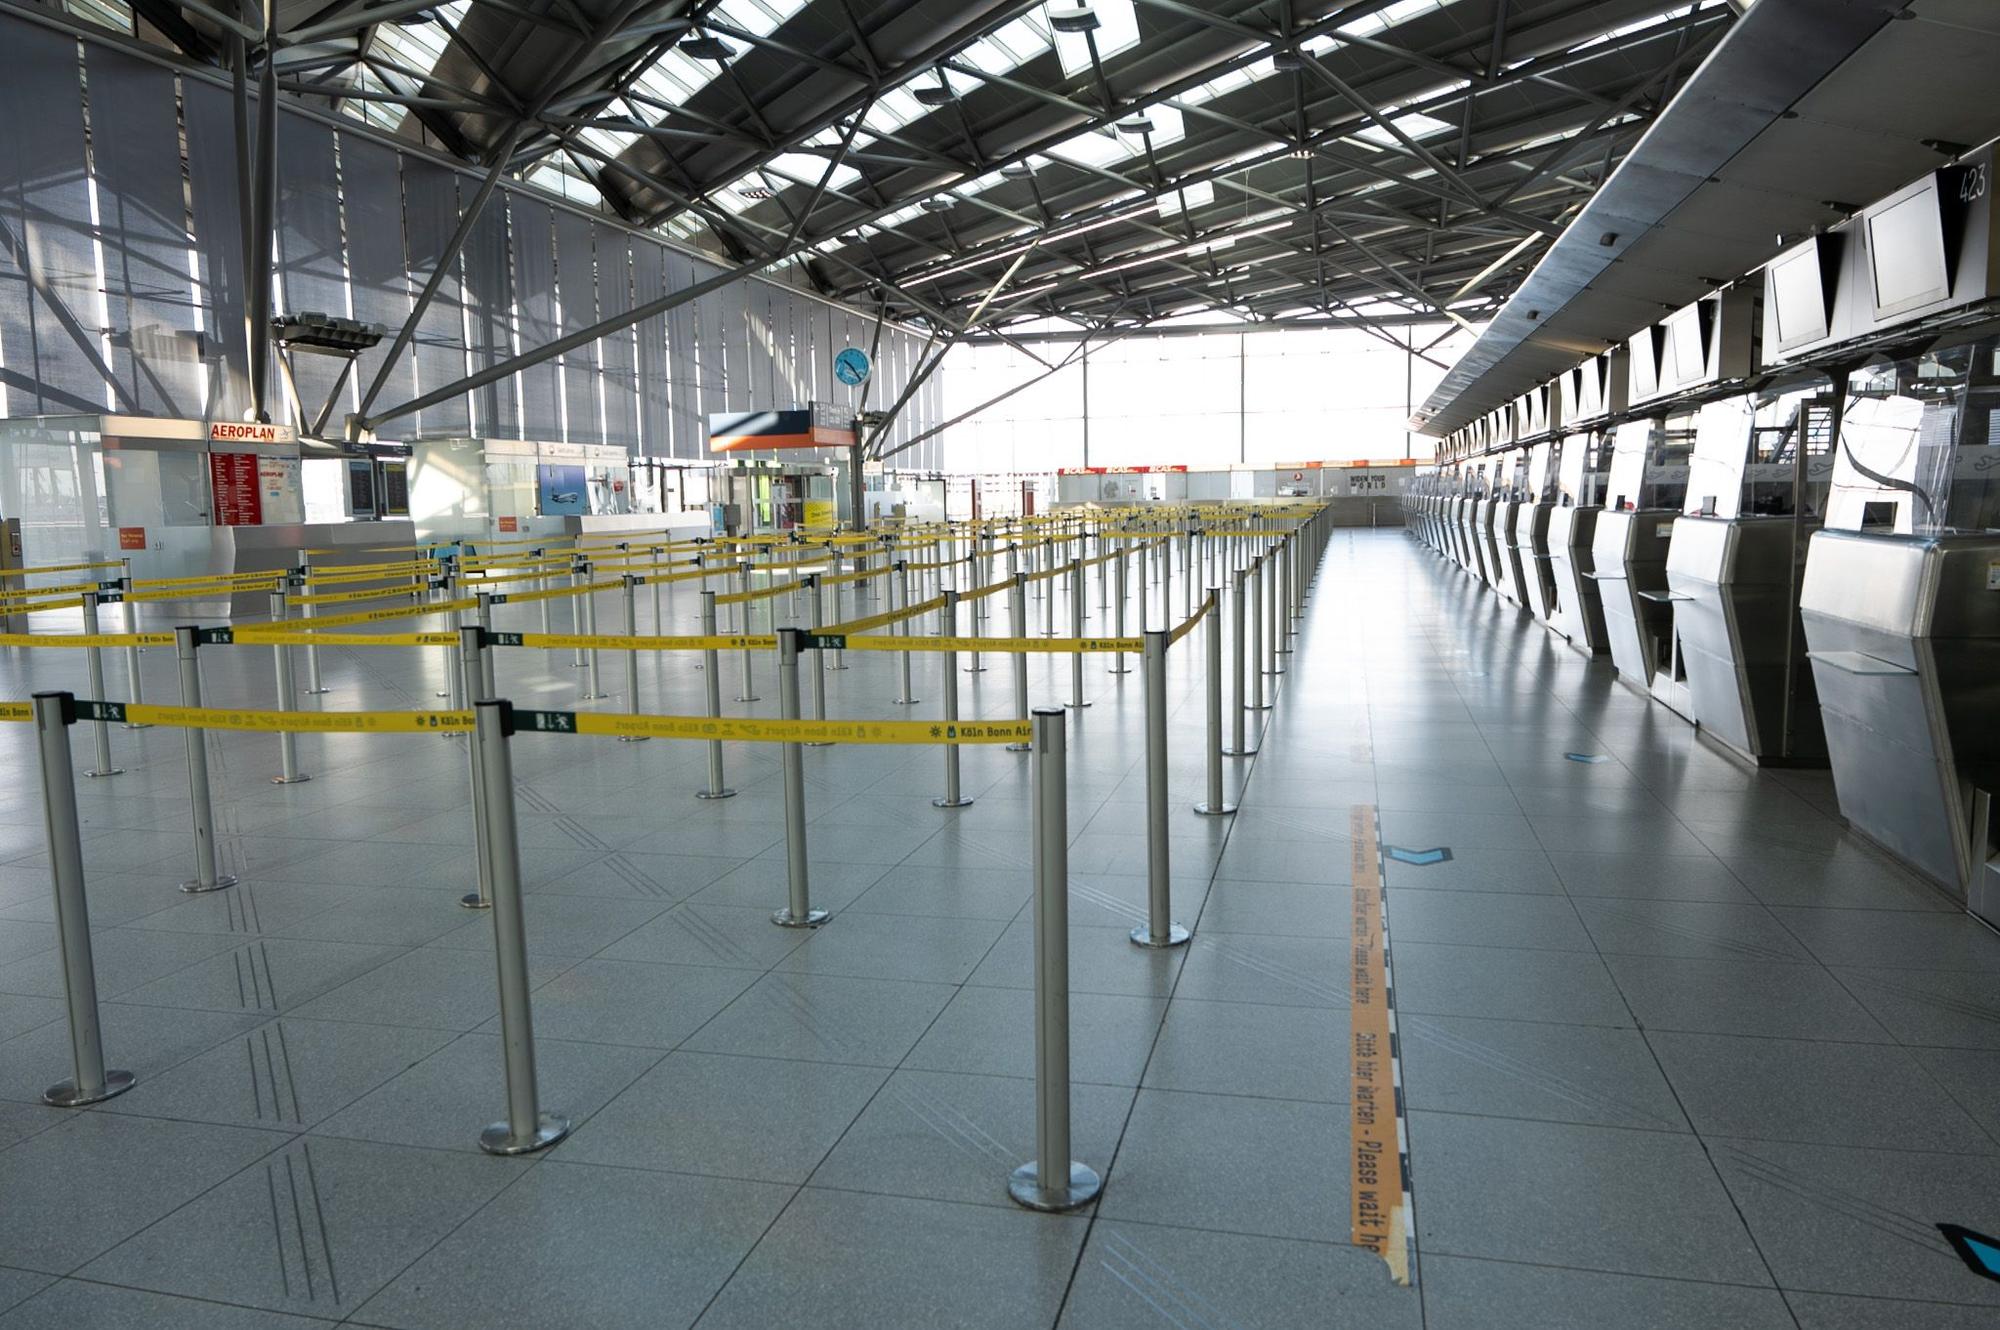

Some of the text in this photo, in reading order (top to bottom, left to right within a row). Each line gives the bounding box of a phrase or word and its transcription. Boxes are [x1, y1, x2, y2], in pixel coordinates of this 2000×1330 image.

[1960, 162, 1986, 202] 423
[211, 424, 275, 440] AEROPLAN
[961, 726, 984, 737] Köln
[987, 726, 1012, 737] Bonn
[1356, 1061, 1378, 1082] hier
[1358, 1140, 1383, 1185] Please
[1358, 1191, 1387, 1227] wait
